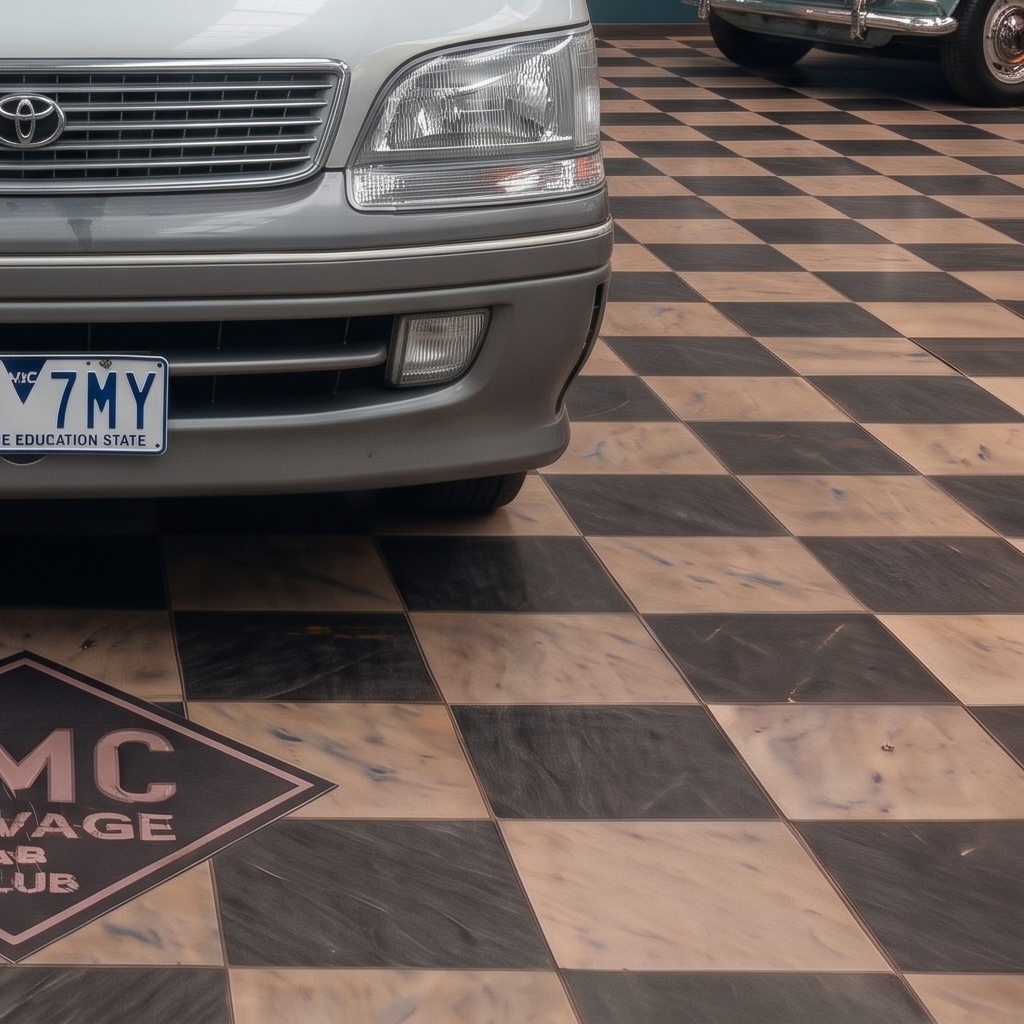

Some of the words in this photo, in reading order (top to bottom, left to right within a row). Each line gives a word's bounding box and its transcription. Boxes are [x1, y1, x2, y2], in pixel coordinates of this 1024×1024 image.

[51, 371, 157, 430] 7MY
[15, 434, 98, 446] EDUCATION
[103, 434, 147, 447] STATE
